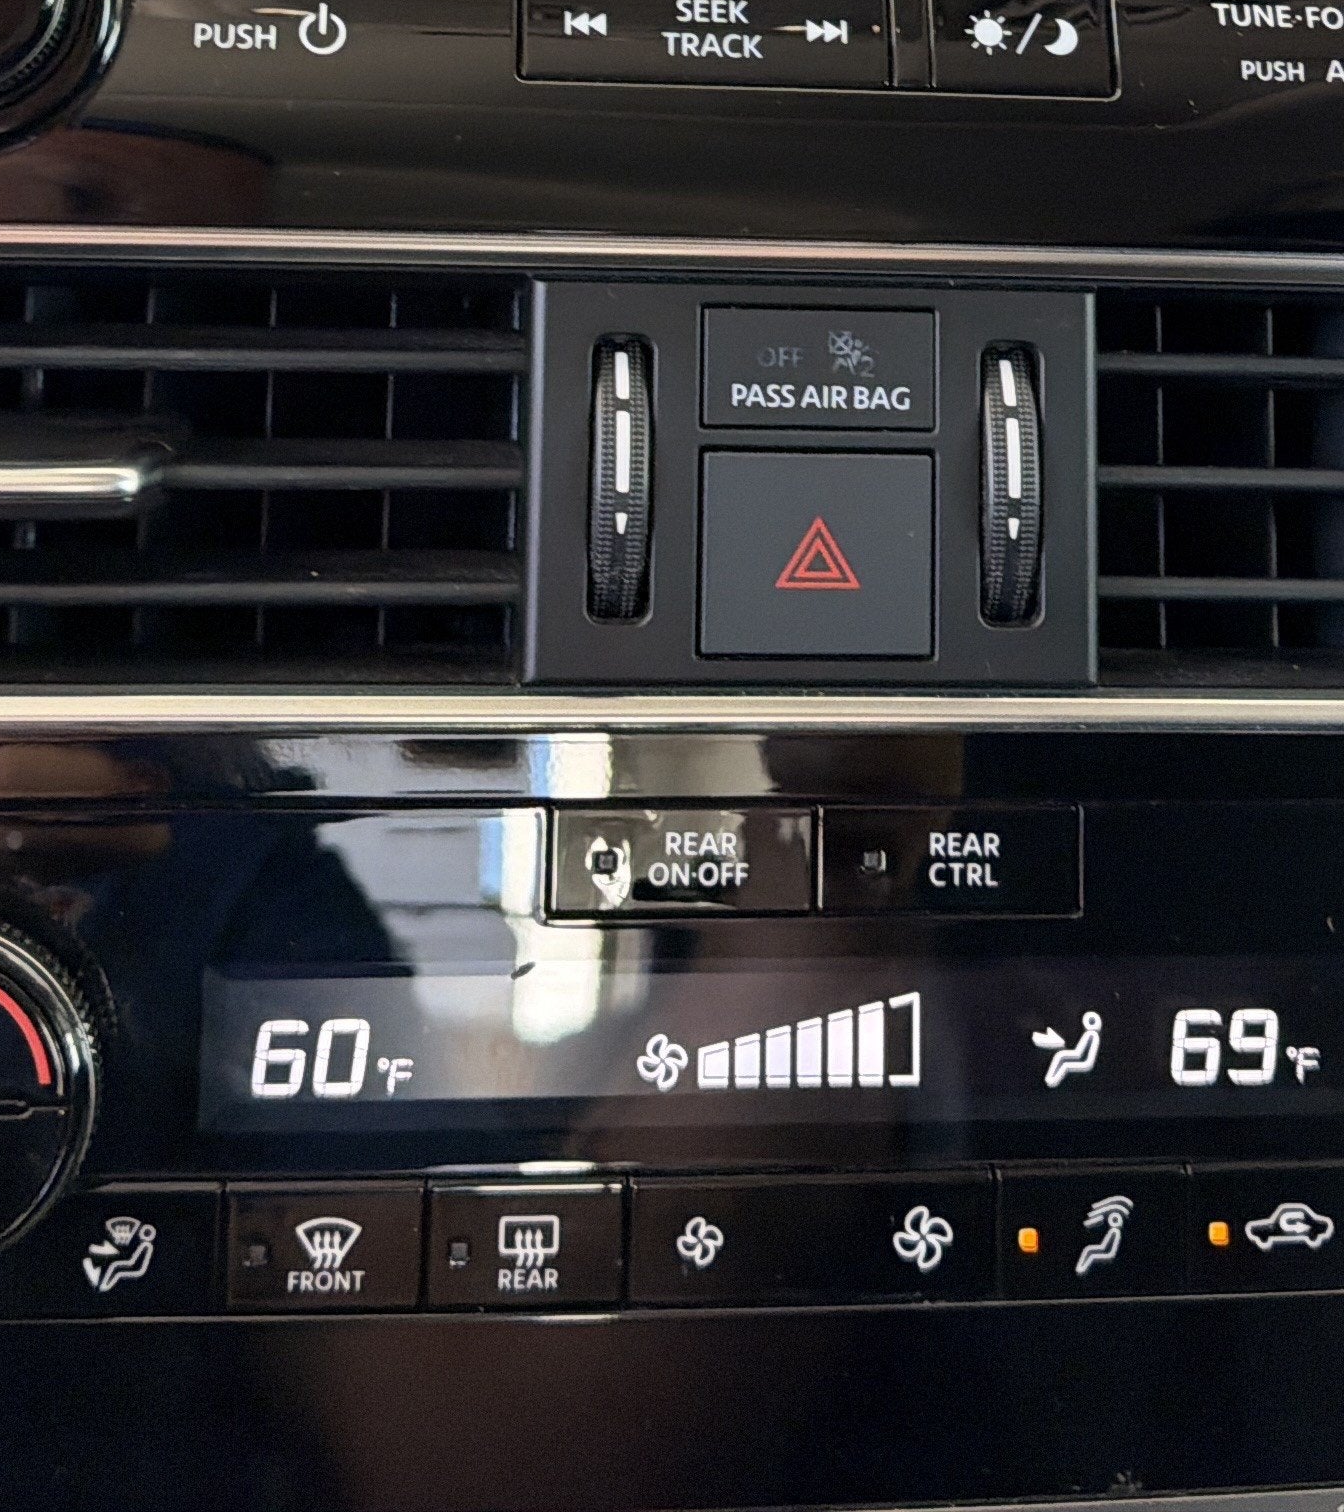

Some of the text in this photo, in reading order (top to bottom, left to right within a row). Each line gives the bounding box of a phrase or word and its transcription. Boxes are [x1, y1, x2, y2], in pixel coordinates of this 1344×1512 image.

[192, 22, 278, 50] PUSH
[660, 31, 763, 60] TRACK
[1239, 58, 1306, 85] PUSH
[757, 345, 805, 369] OFF
[730, 382, 911, 411] PASS AIR BAG
[664, 831, 738, 857] REAR
[927, 831, 1001, 858] REAR
[927, 861, 1000, 887] CTRL
[287, 1269, 366, 1292] FRONT
[497, 1267, 559, 1291] REAR
